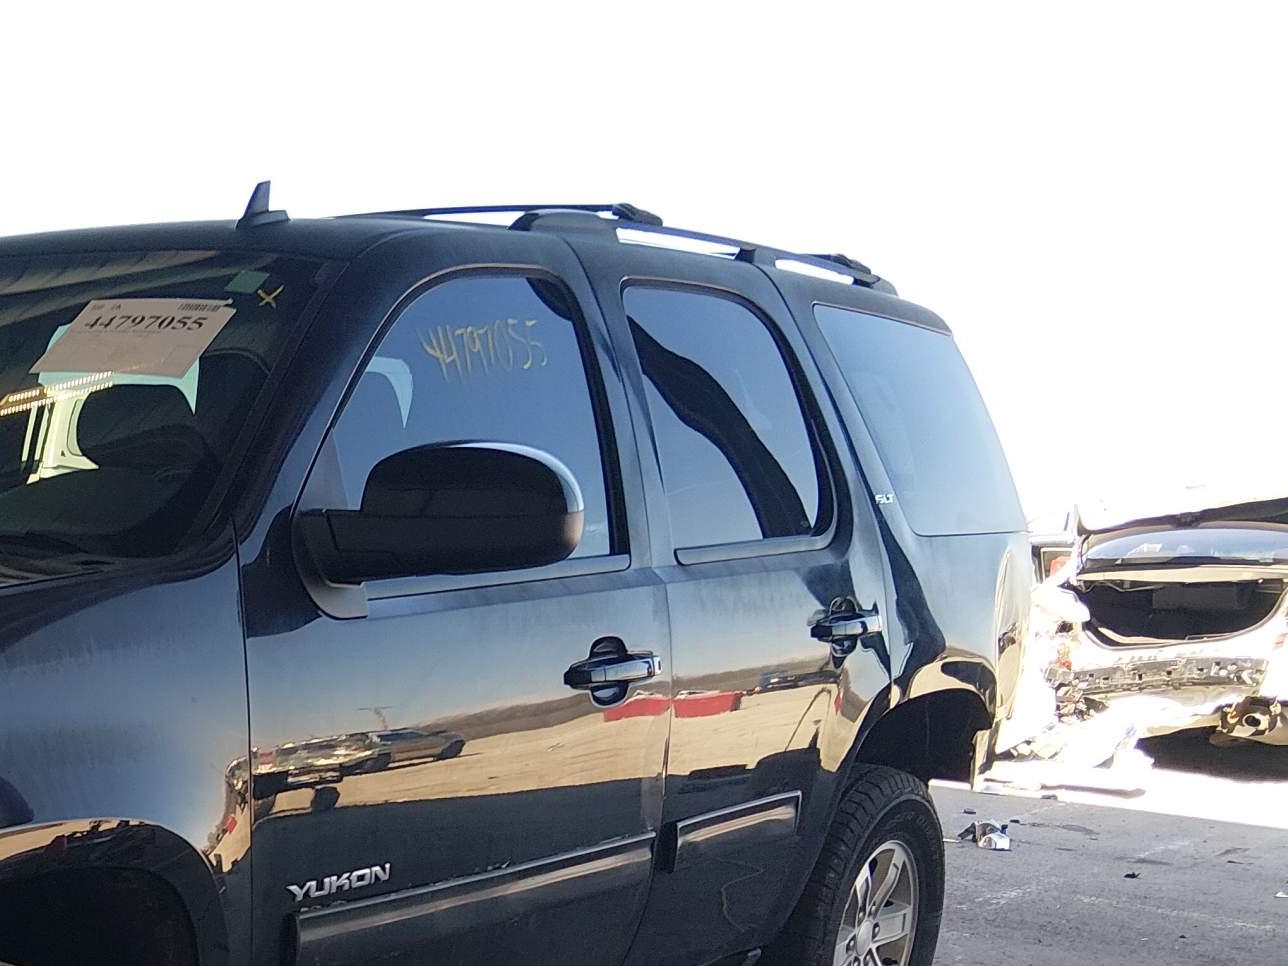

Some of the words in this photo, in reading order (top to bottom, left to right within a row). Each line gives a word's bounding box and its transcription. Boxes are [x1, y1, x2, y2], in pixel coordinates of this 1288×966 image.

[84, 314, 209, 332] 44797055
[416, 318, 549, 384] 44797055
[286, 862, 391, 902] YUKON
